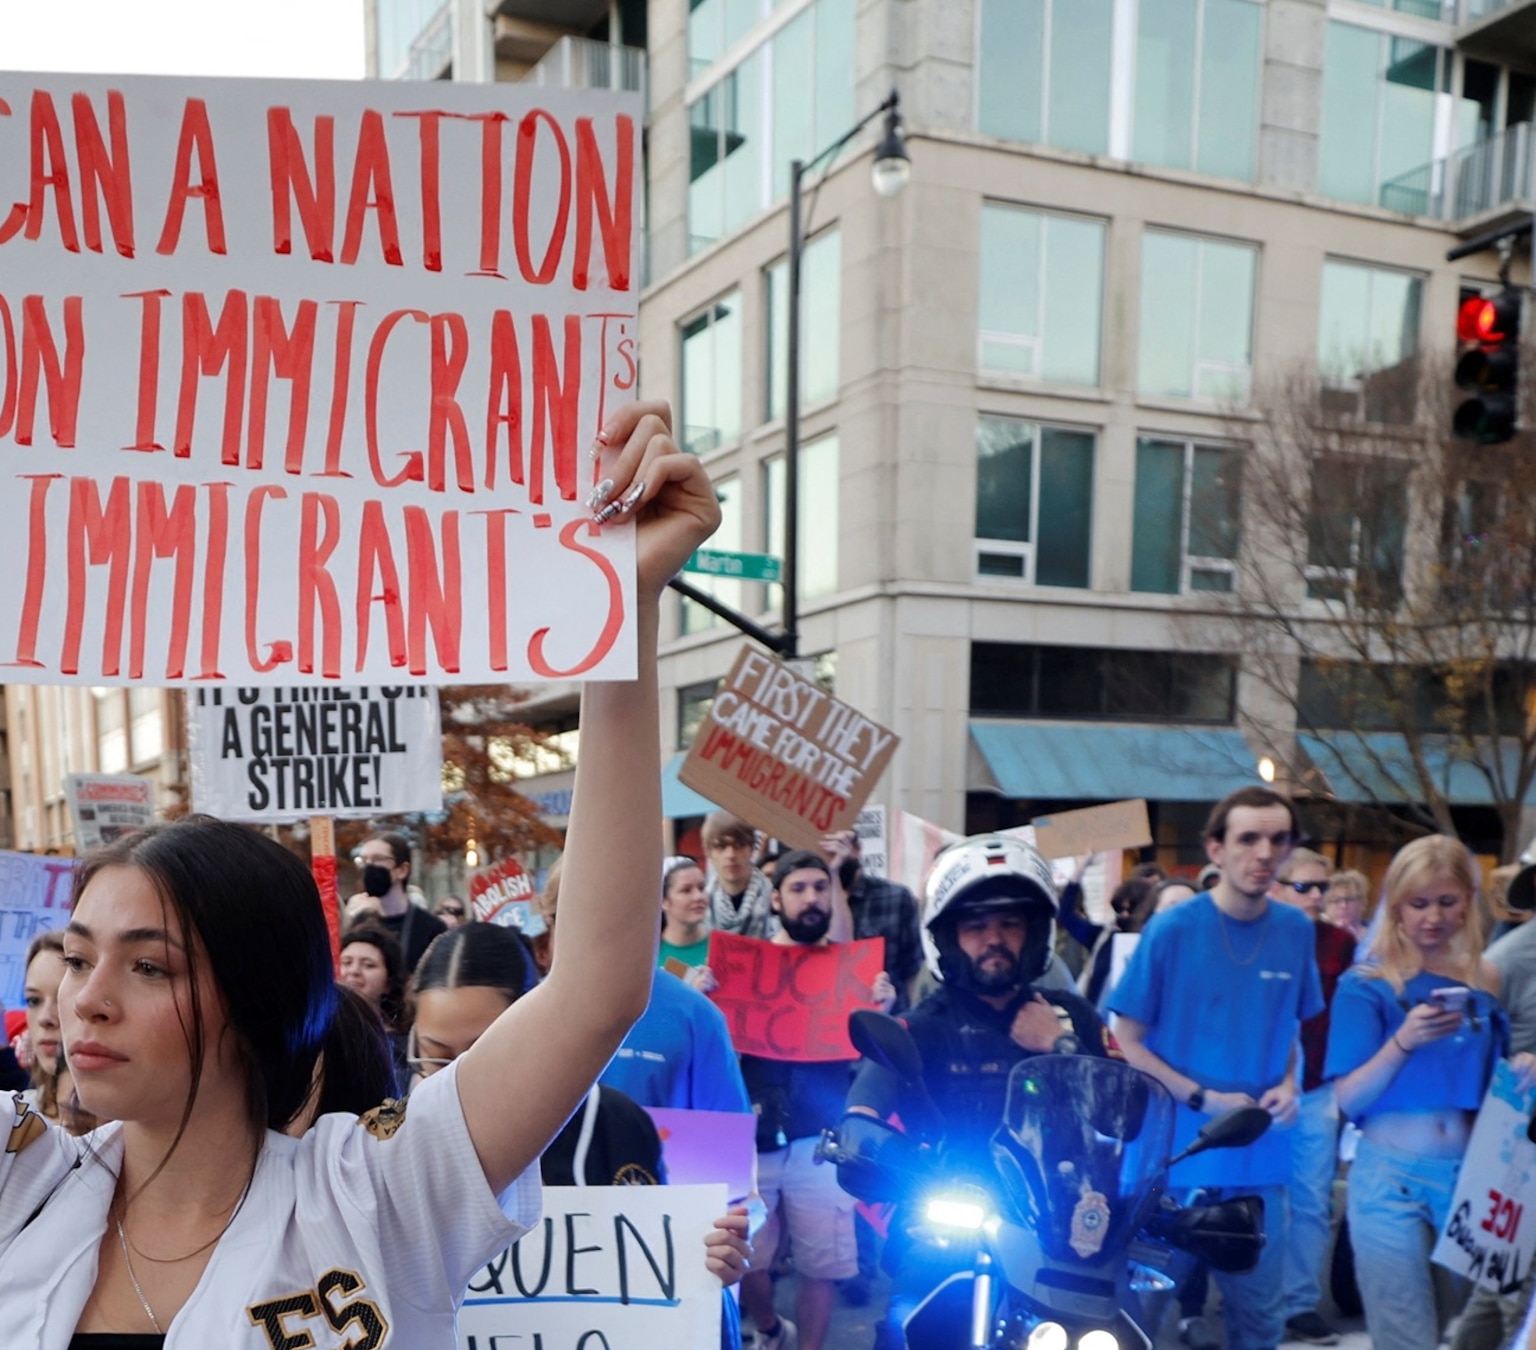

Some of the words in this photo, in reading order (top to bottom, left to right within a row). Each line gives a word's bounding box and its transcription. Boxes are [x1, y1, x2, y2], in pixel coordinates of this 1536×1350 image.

[156, 97, 227, 255] A
[267, 105, 634, 291] NATION
[222, 707, 243, 759] A
[250, 701, 406, 757] GENERAL
[733, 651, 827, 729] FIRST
[816, 699, 893, 772] THEY
[711, 691, 779, 749] CAME
[773, 728, 824, 774] FOR
[817, 752, 862, 798] THE
[248, 755, 382, 810] STRIKE!
[699, 728, 846, 831] IMMIGRANTS
[472, 873, 531, 923] ABOLISH
[714, 935, 874, 1004] FUCK
[717, 999, 844, 1056] ICE
[1481, 1188, 1523, 1244] ICE
